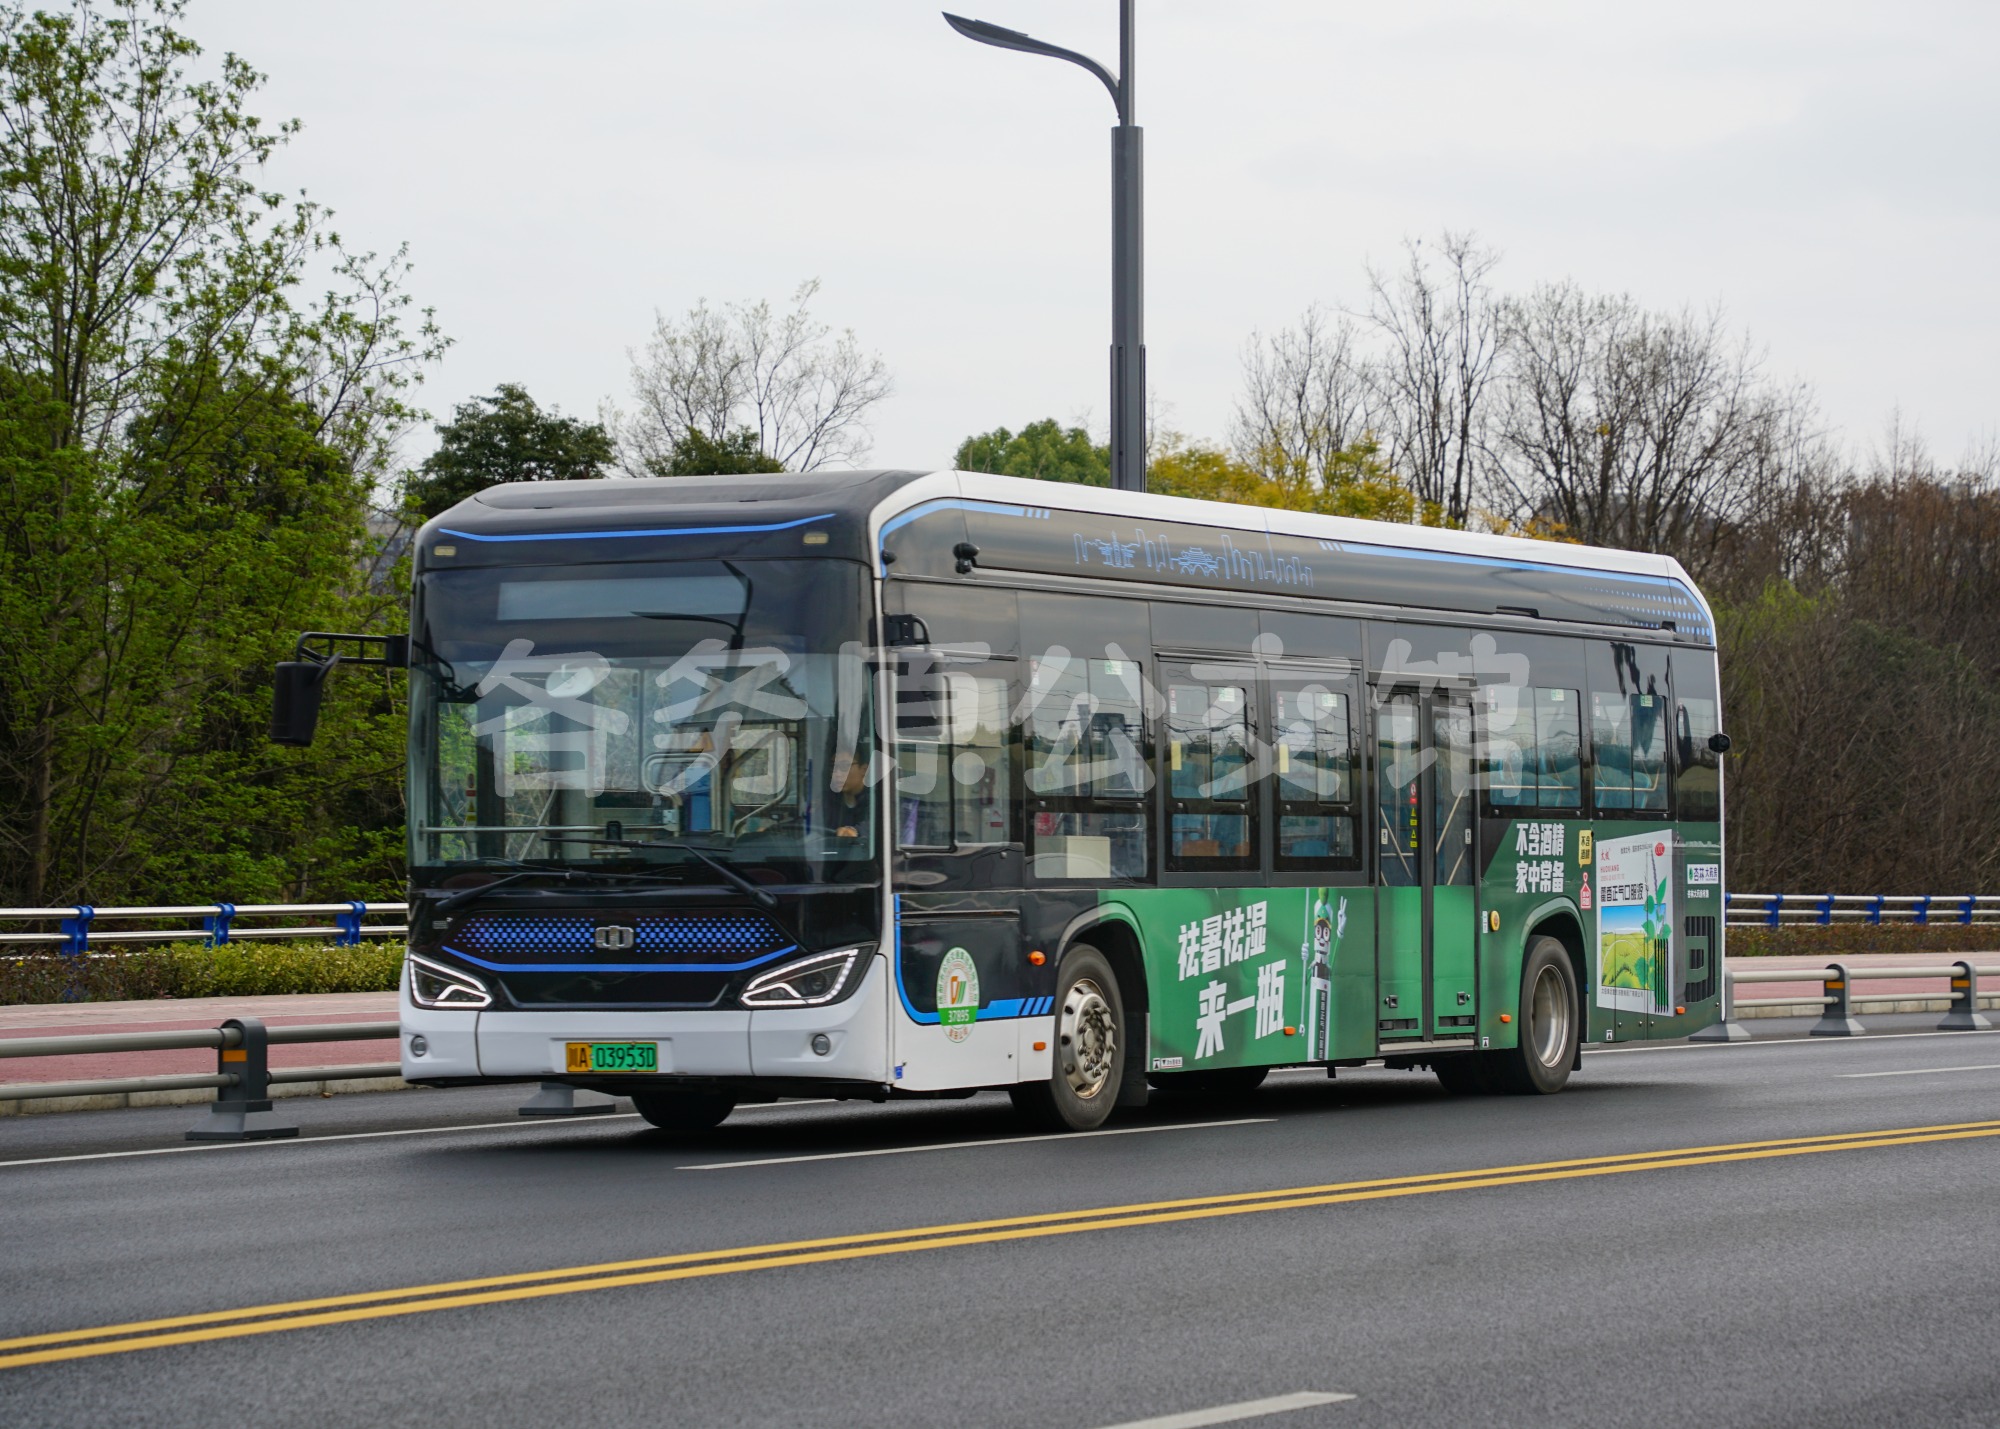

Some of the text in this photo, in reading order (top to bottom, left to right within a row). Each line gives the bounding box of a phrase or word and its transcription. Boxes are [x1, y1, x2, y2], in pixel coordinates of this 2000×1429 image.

[1516, 823, 1564, 856] 不含酒精
[1516, 860, 1564, 893] 家中常备
[1600, 882, 1644, 902] 藿香正气口服液
[1177, 900, 1267, 981] 祛暑祛湿
[1194, 958, 1287, 1060] 来一瓶
